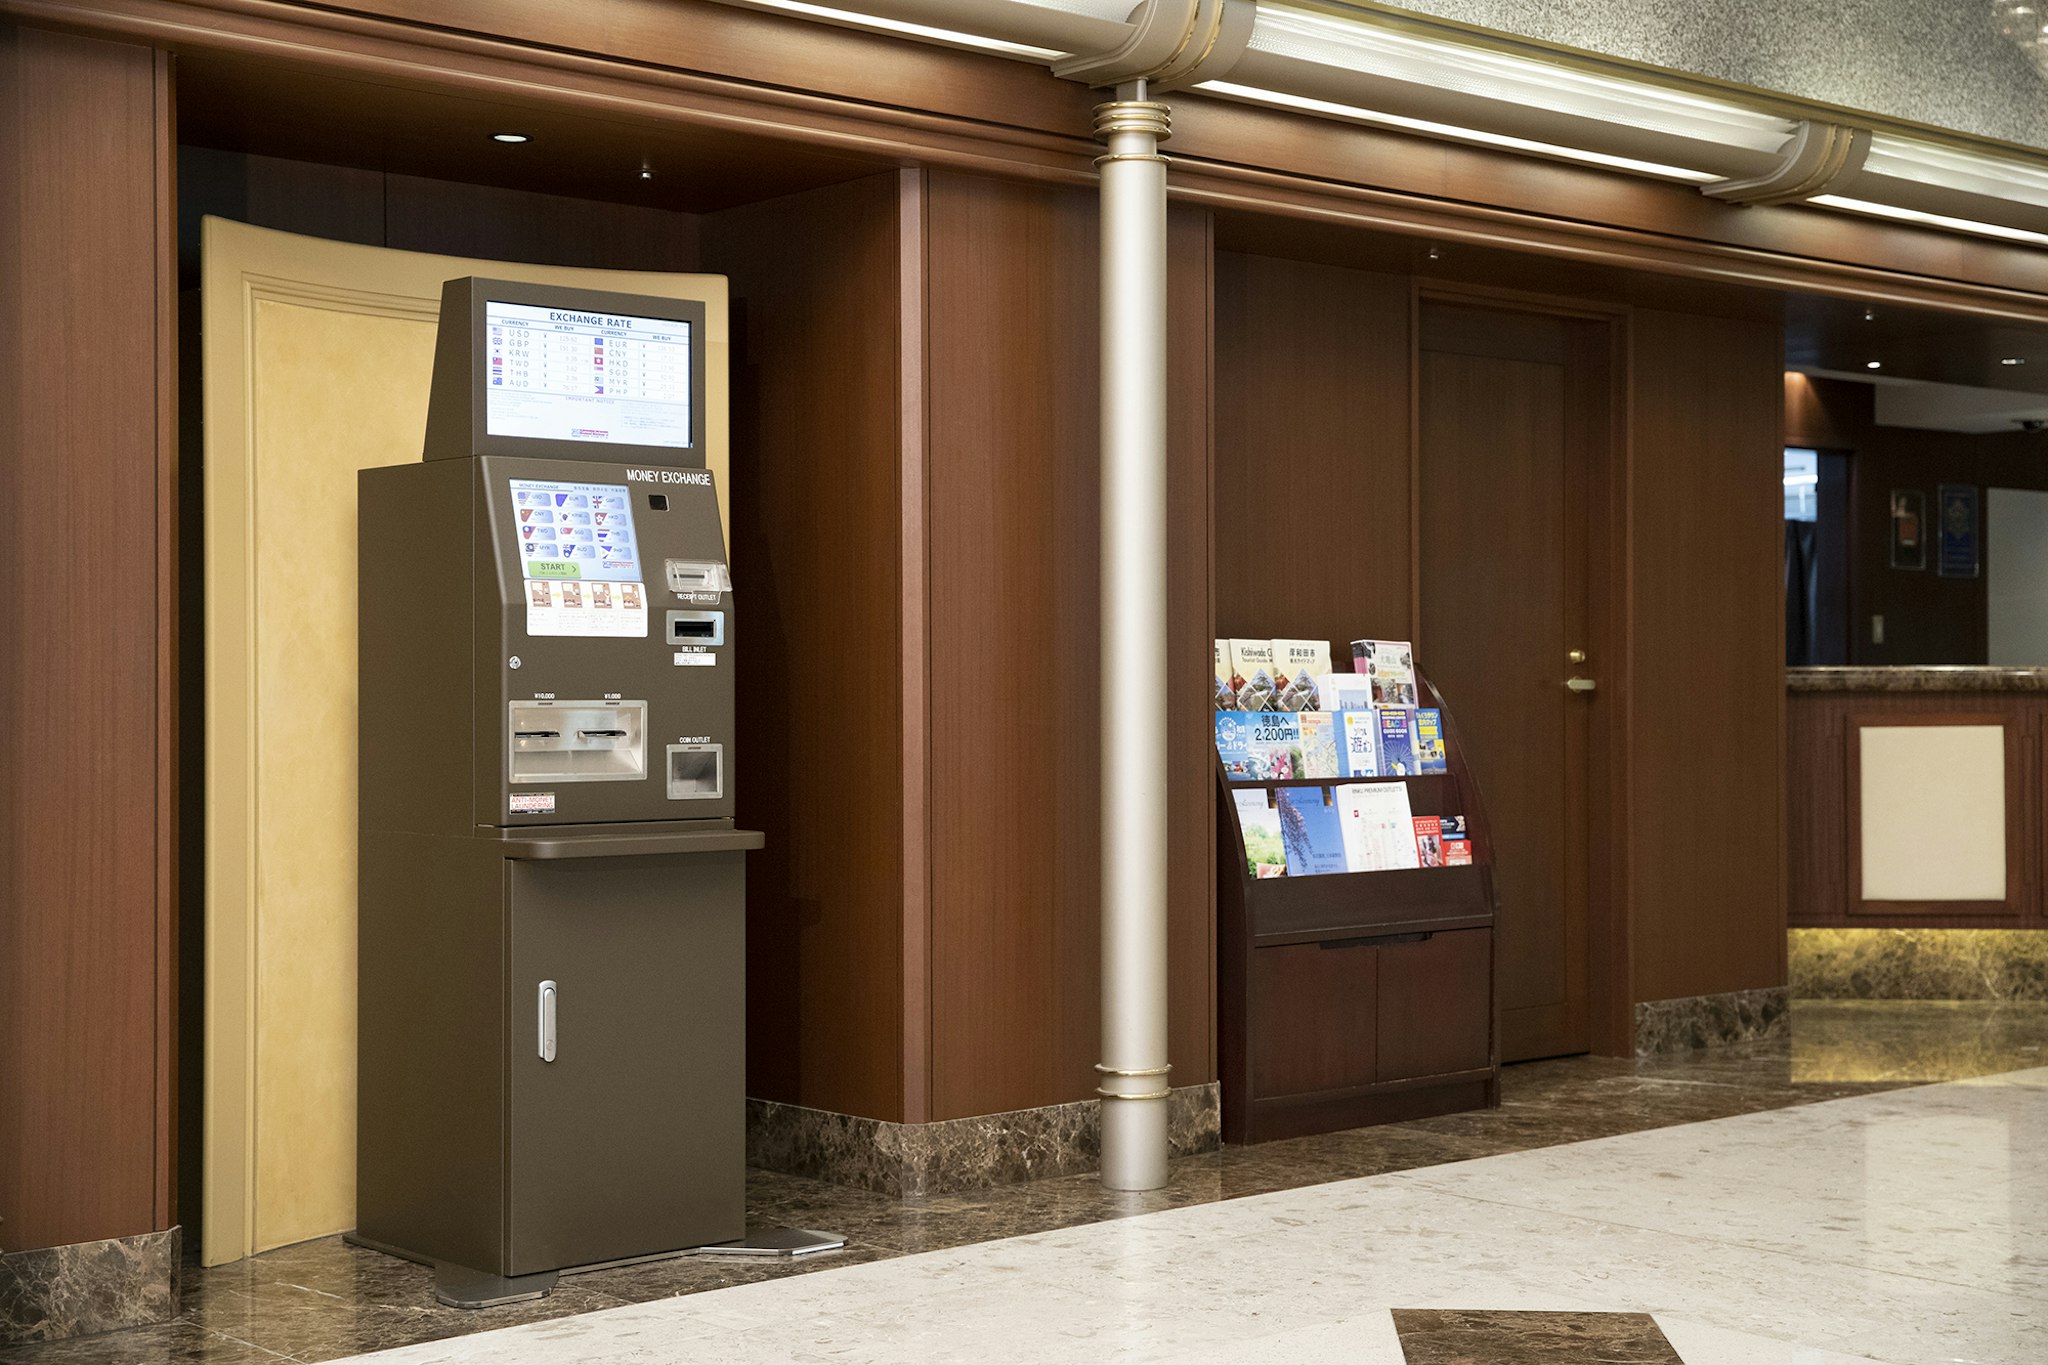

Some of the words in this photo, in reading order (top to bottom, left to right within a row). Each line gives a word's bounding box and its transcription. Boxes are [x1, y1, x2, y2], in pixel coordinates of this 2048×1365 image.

[501, 319, 529, 327] CURRENCY
[550, 312, 603, 326] EXCHANGE
[607, 318, 632, 329] RATE
[509, 329, 530, 338] USD
[509, 339, 529, 347] GBP
[609, 340, 628, 348] EUR
[509, 349, 529, 358] KRW
[609, 349, 627, 357] CNY
[509, 359, 529, 368] TWD
[609, 360, 628, 368] HKD
[509, 369, 529, 377] THB
[609, 369, 628, 377] SGD
[509, 379, 529, 387] AUD
[609, 378, 628, 386] MYR
[626, 469, 659, 482] MONEY
[661, 471, 711, 486] EXCHANGE
[1241, 647, 1266, 657] Kishiwada
[1289, 647, 1316, 658] 岸和田市
[1261, 714, 1289, 728] 徳島へ
